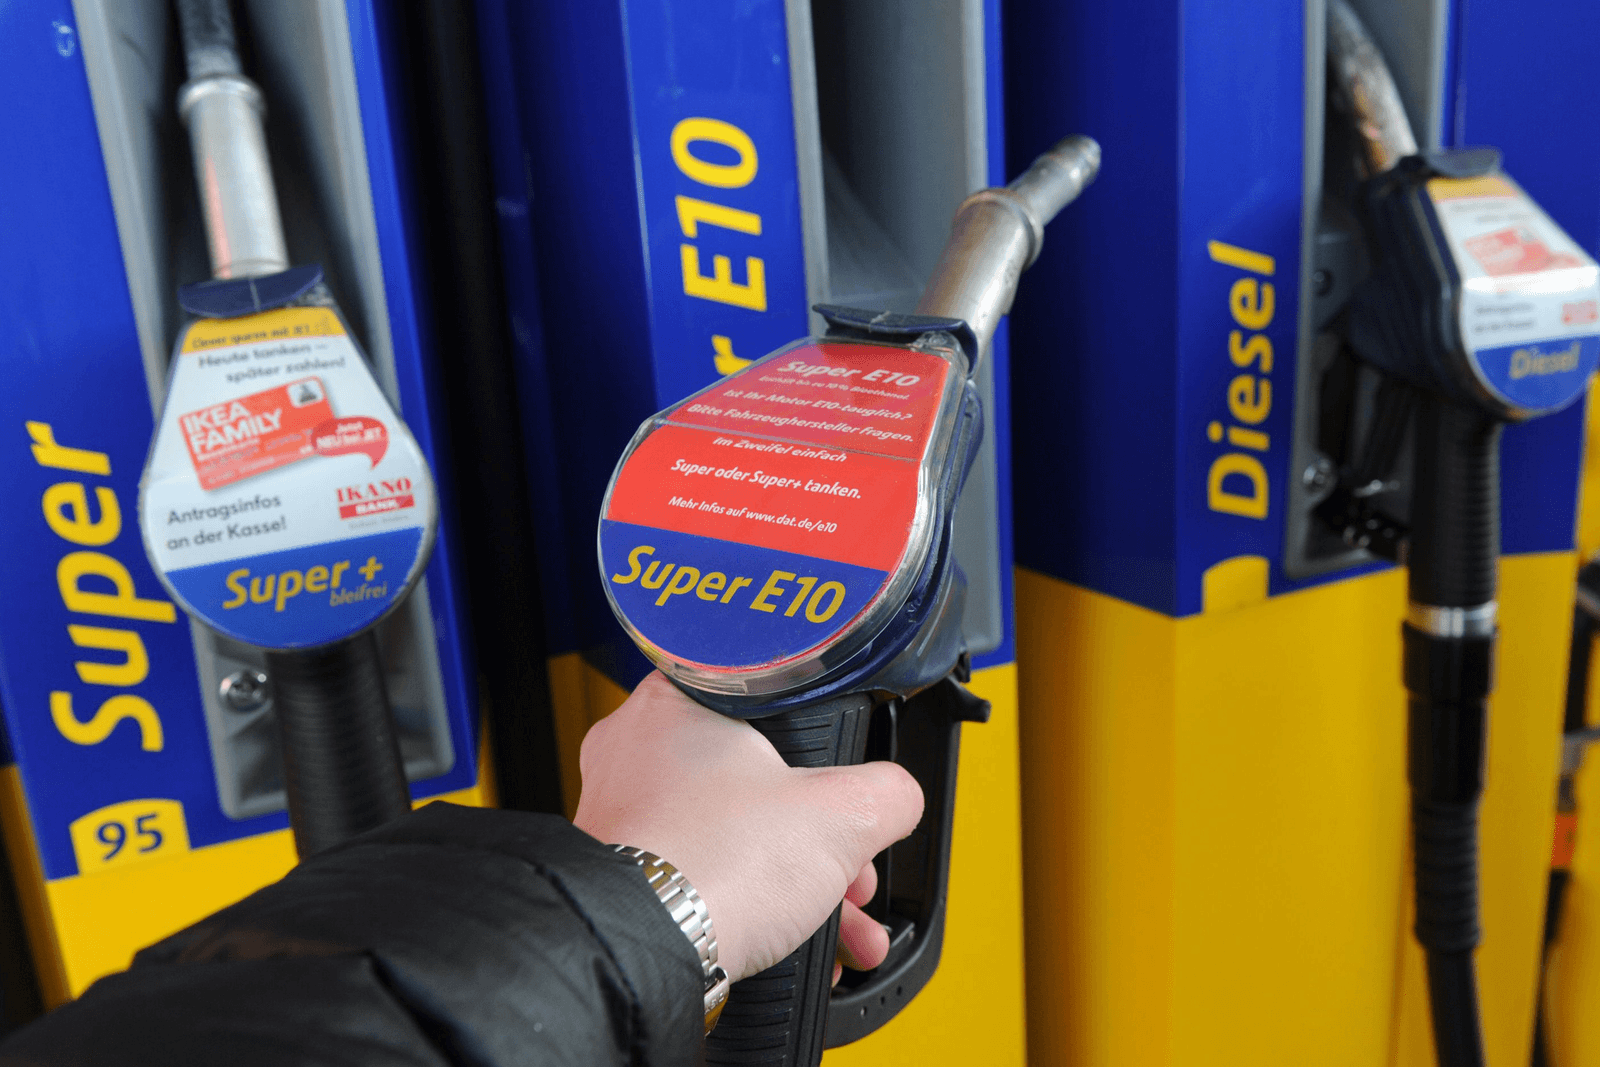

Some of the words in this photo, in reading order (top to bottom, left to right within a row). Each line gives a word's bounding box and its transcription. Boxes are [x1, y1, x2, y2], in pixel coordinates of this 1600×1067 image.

[669, 116, 767, 312] E10
[198, 351, 249, 368] Heute
[253, 344, 312, 360] tanken
[226, 366, 279, 383] später
[286, 356, 345, 373] zahlen!
[777, 360, 862, 379] Super
[862, 368, 921, 387] E10
[1509, 342, 1581, 380] Diesel
[1207, 240, 1276, 520] Diesel
[183, 401, 249, 432] IKEA
[723, 389, 742, 399] Ist
[743, 391, 766, 401] Ihr
[765, 394, 813, 406] Motor
[812, 400, 913, 420] E10-tauglich?
[190, 408, 282, 453] FAMILY
[687, 404, 722, 416] Bitte
[723, 407, 860, 434] Fahrzeughersteller
[859, 426, 914, 442] fragen.
[734, 438, 793, 455] Zweifel
[792, 447, 848, 462] einfach
[337, 477, 412, 503] IKANO
[671, 459, 715, 478] Super
[715, 467, 752, 481] oder
[749, 470, 802, 489] Super+
[803, 479, 861, 499] tanken.
[167, 495, 282, 526] Antragsinfos
[356, 500, 397, 515] BANK
[668, 496, 699, 509] Mehr
[698, 501, 725, 515] Infos
[725, 506, 747, 519] auf
[745, 510, 837, 534] www.dat.de/e10
[166, 536, 190, 550] an
[193, 530, 222, 546] der
[226, 516, 286, 541] Kasse!
[25, 420, 177, 752] Super
[222, 560, 350, 612] Super
[358, 556, 383, 581] +
[329, 580, 388, 607] bleifrei
[612, 545, 753, 606] Super
[749, 570, 846, 623] E10
[95, 811, 163, 861] 95
